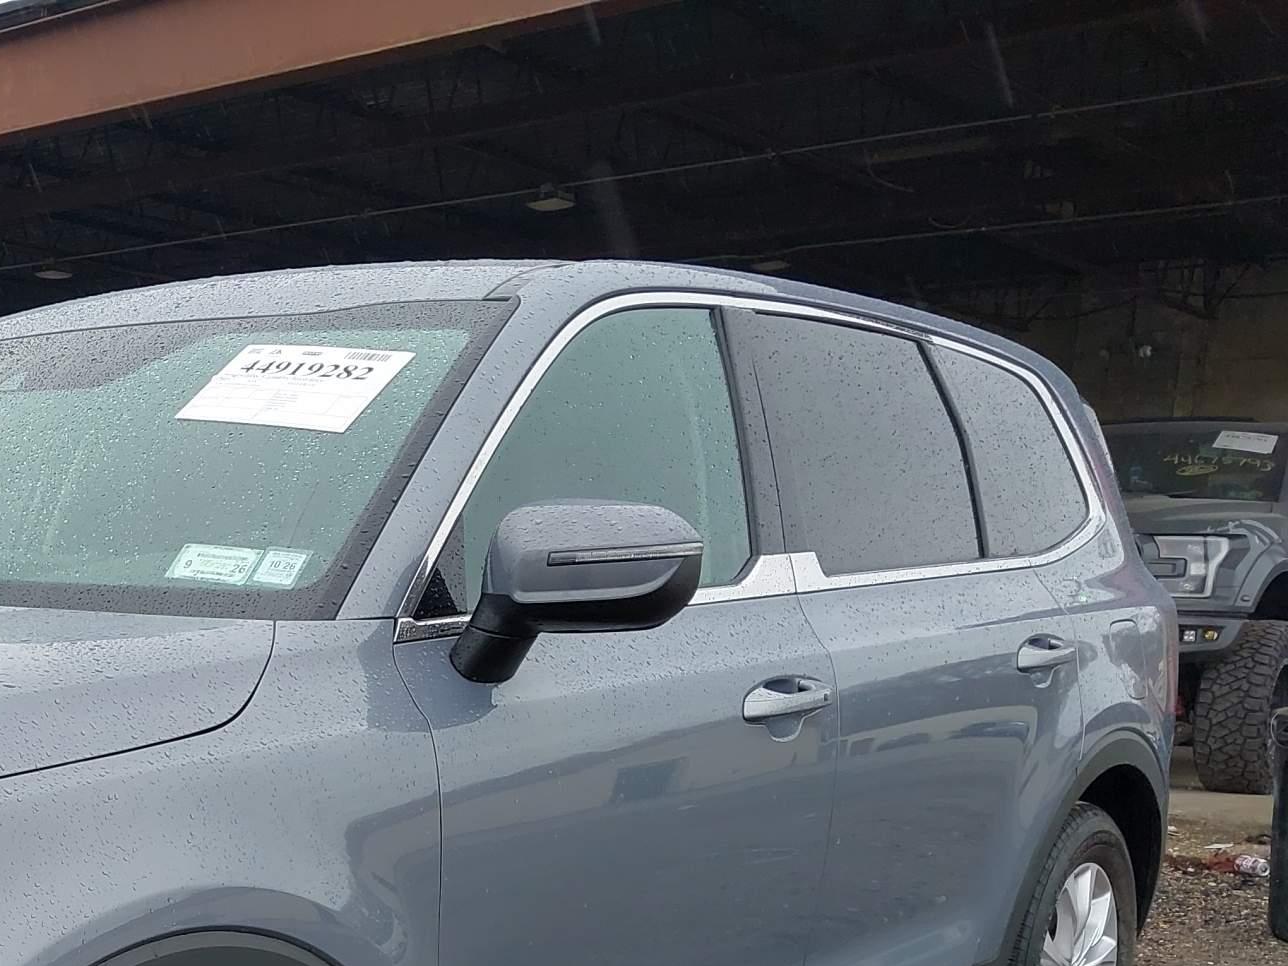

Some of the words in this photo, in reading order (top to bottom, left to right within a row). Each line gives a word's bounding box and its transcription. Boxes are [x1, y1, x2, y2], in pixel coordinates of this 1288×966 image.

[241, 359, 374, 380] 44919282
[231, 563, 247, 574] 26
[283, 561, 297, 570] 26
